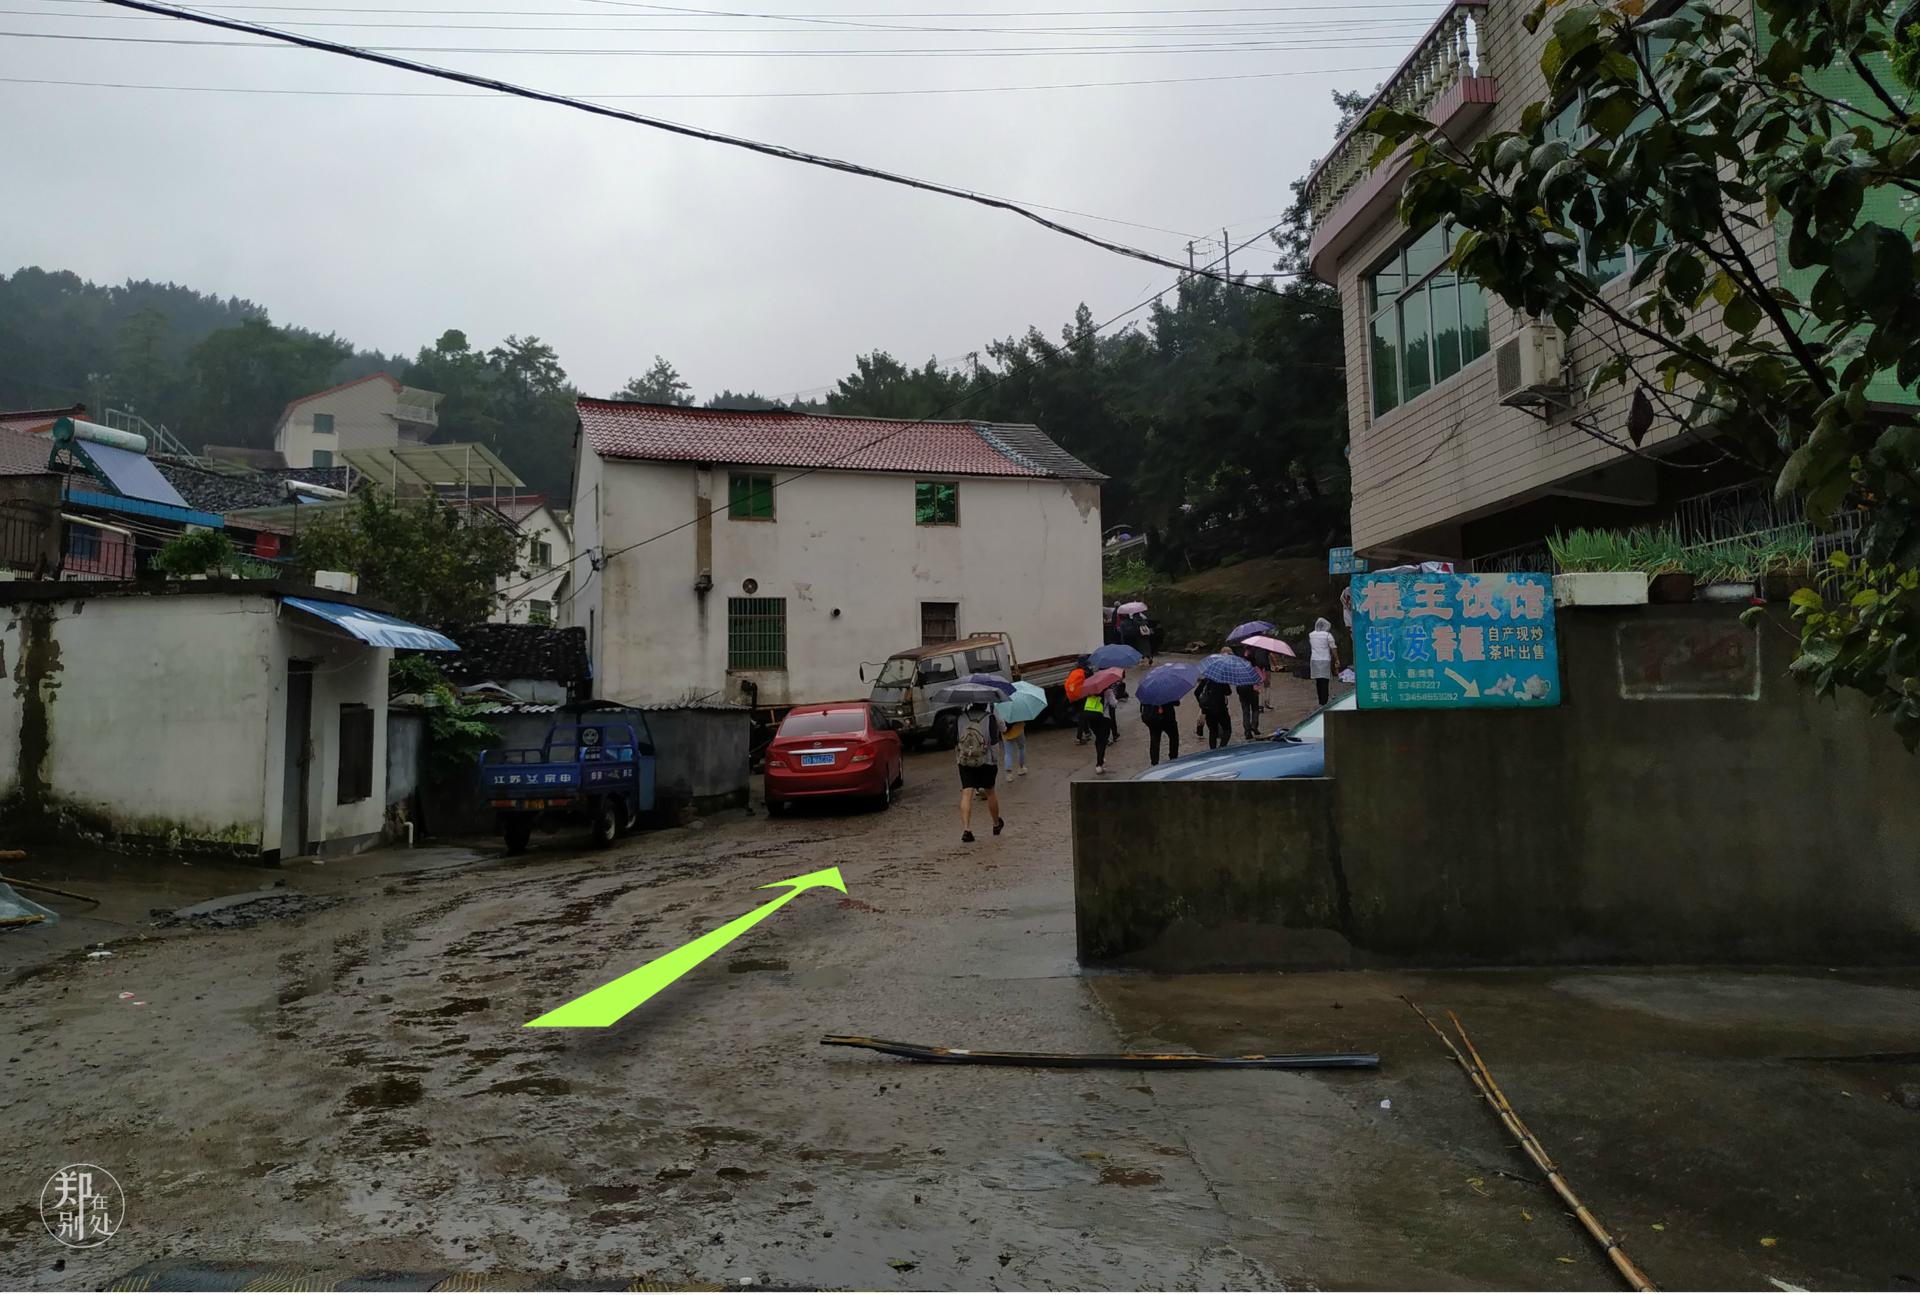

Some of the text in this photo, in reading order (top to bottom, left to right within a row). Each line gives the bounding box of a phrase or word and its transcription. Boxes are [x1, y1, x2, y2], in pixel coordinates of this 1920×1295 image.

[1360, 579, 1546, 621] 榧王饭馆
[1489, 626, 1544, 642] 自产现炒
[1489, 645, 1545, 660] 茶叶出售
